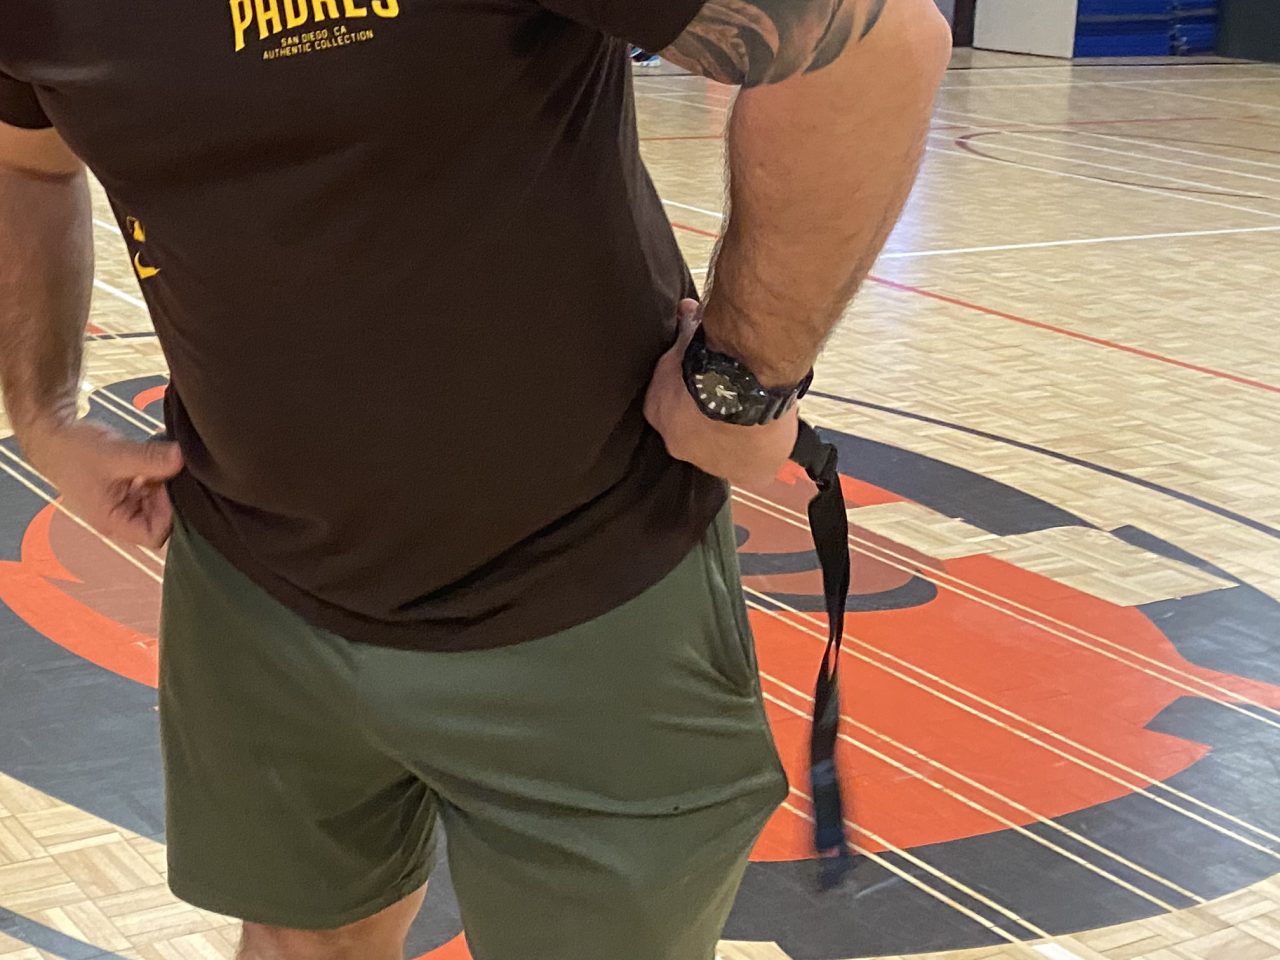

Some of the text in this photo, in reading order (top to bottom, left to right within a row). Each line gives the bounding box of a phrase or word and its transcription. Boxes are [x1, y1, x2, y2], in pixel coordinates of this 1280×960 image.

[262, 29, 375, 60] AUTHENTIC COLLECTION
[280, 35, 300, 47] SAN
[333, 25, 348, 36] CA
